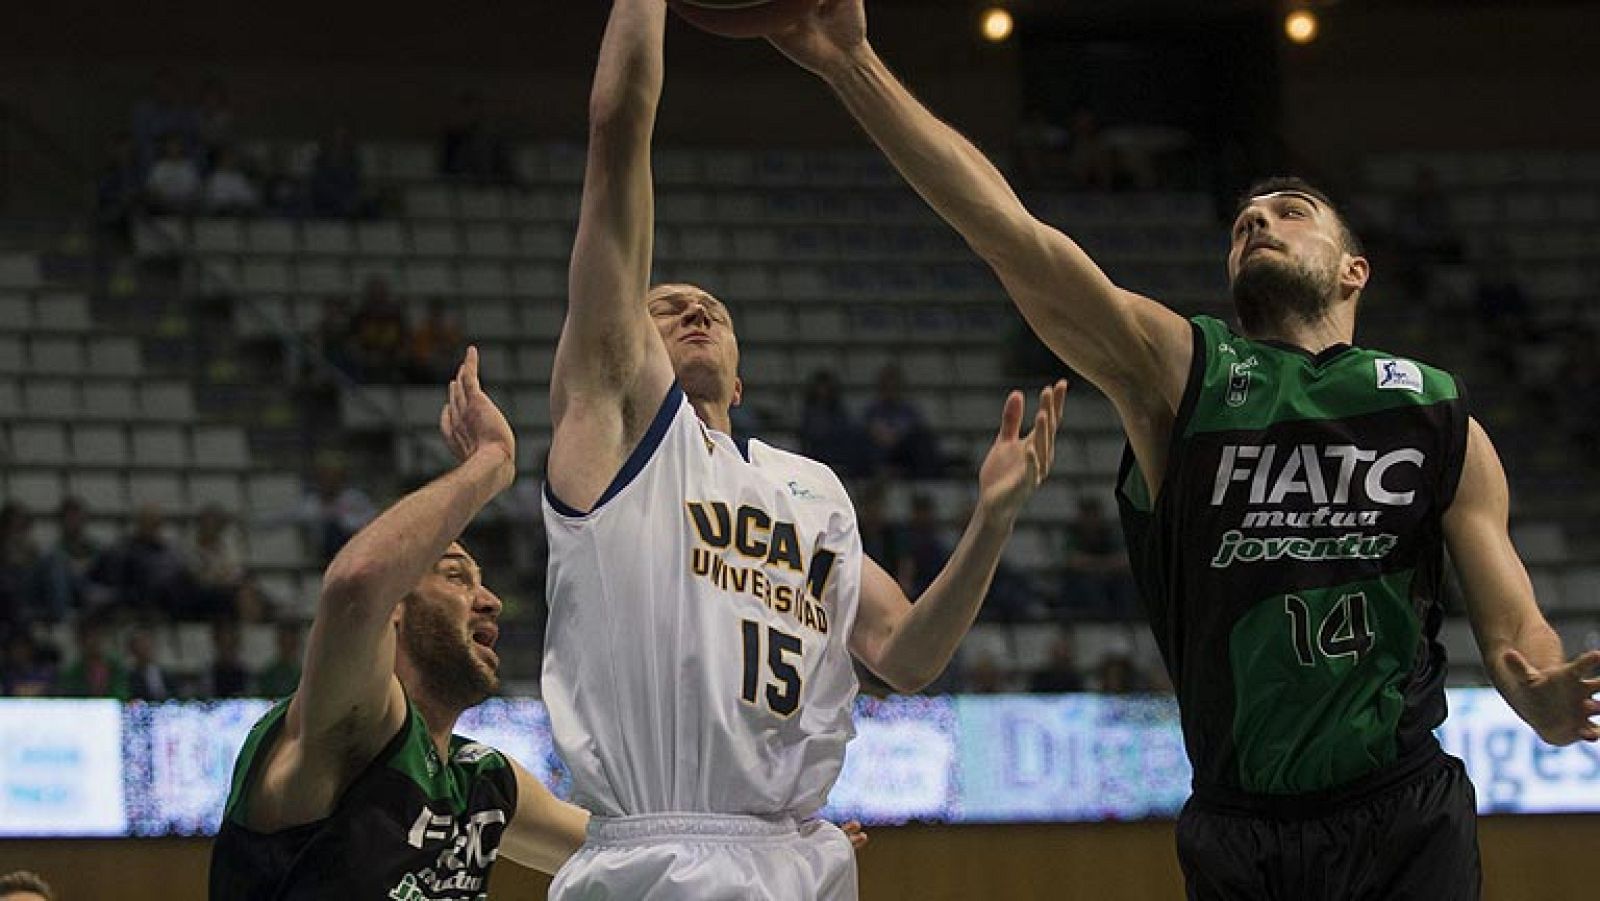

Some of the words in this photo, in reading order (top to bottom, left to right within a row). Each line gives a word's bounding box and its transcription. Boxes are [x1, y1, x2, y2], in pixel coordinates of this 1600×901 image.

[1210, 444, 1426, 506] FIATC
[1241, 506, 1382, 529] mutua
[692, 547, 829, 635] UNIVERSIAD
[1284, 592, 1375, 667] 14
[740, 618, 803, 717] 15
